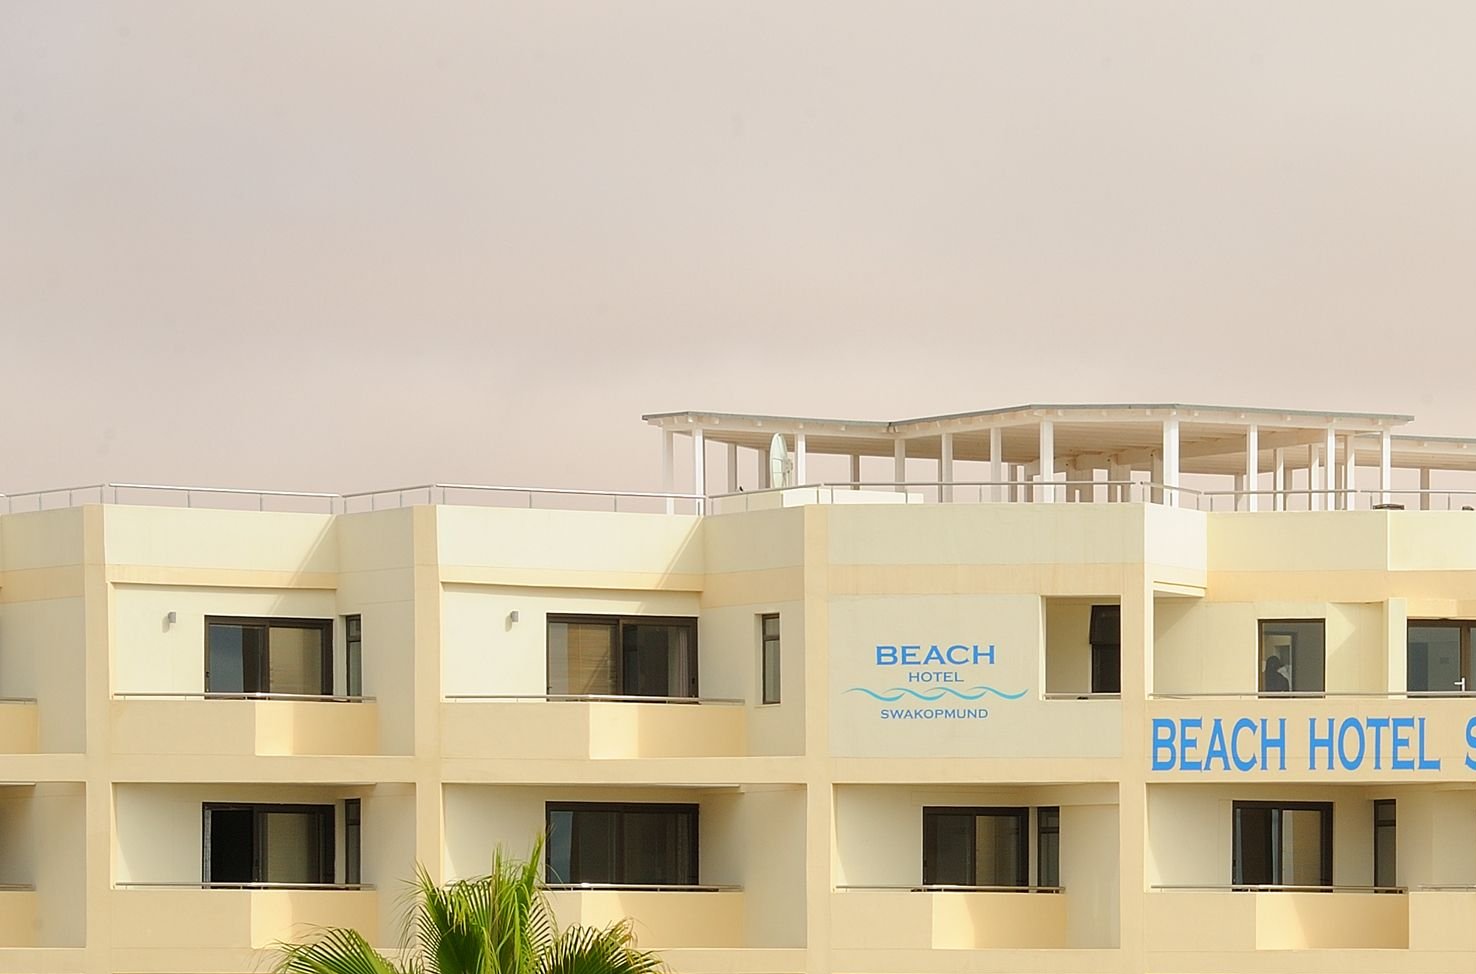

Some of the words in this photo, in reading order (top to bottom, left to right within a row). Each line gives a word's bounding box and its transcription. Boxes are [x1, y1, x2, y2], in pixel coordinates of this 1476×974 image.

[875, 645, 996, 666] BEACH
[908, 671, 965, 683] HOTEL
[880, 708, 989, 719] SWAKOPMUND
[1151, 716, 1287, 772] BEACH
[1308, 716, 1441, 771] HOTEL
